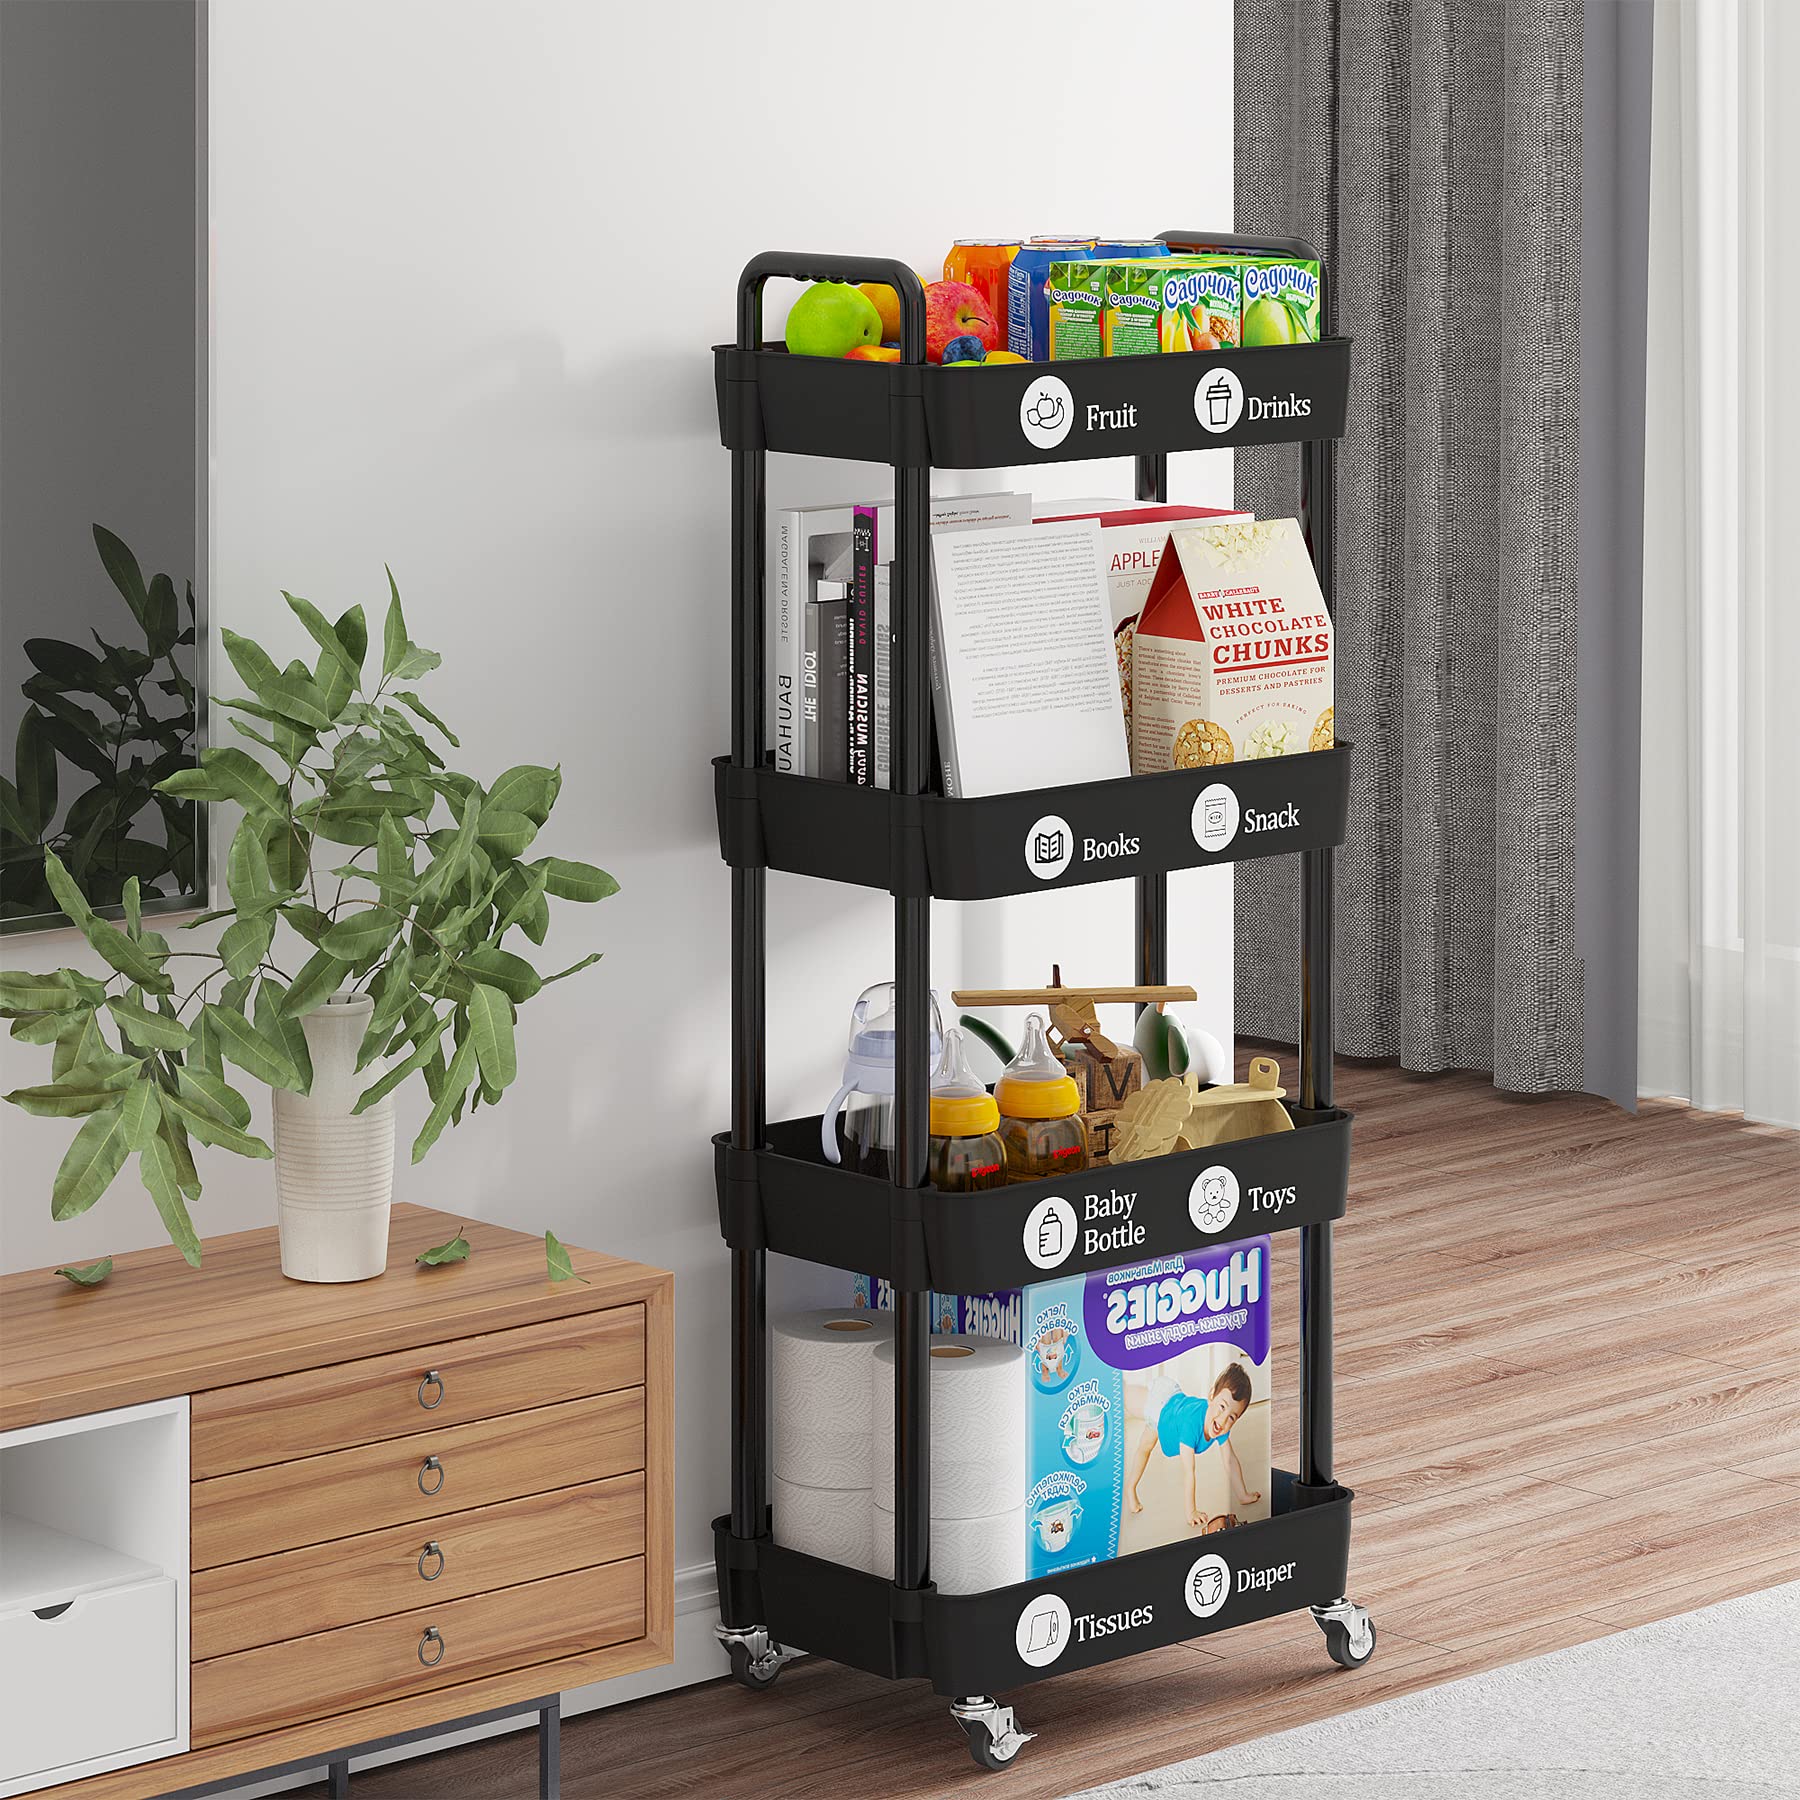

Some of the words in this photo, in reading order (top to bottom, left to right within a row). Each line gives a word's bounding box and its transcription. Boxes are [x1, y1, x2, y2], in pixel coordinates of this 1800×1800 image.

[1164, 273, 1239, 310] Садочок
[1245, 265, 1318, 299] Садочок
[1052, 289, 1102, 306] Садочок
[1109, 293, 1160, 311] Садочок
[1085, 403, 1138, 431] Fruit
[1247, 393, 1312, 421] Drinks
[1110, 549, 1160, 572] APPLE
[1116, 580, 1135, 588] JUST
[1202, 598, 1285, 621] WHITE
[1209, 614, 1327, 640] CHOCOLATE
[1213, 633, 1329, 664] CHUNKS
[1216, 674, 1256, 686] PREMIUM
[1258, 668, 1308, 681] CHOCOLATE
[1309, 666, 1326, 674] FOR
[1219, 684, 1262, 696] DESSERTS
[1264, 682, 1282, 691] AND
[1283, 677, 1323, 688] PASTRIES
[1236, 704, 1265, 724] PERFECT
[1282, 702, 1308, 715] BAKING
[1243, 802, 1301, 834] Snack
[1082, 833, 1141, 862] Books
[1103, 1062, 1134, 1101] V
[1084, 1189, 1137, 1221] Baby
[1247, 1185, 1296, 1214] Toys
[1084, 1220, 1146, 1256] Bottle
[1236, 1561, 1297, 1593] Diaper
[1073, 1605, 1153, 1643] Tissues
